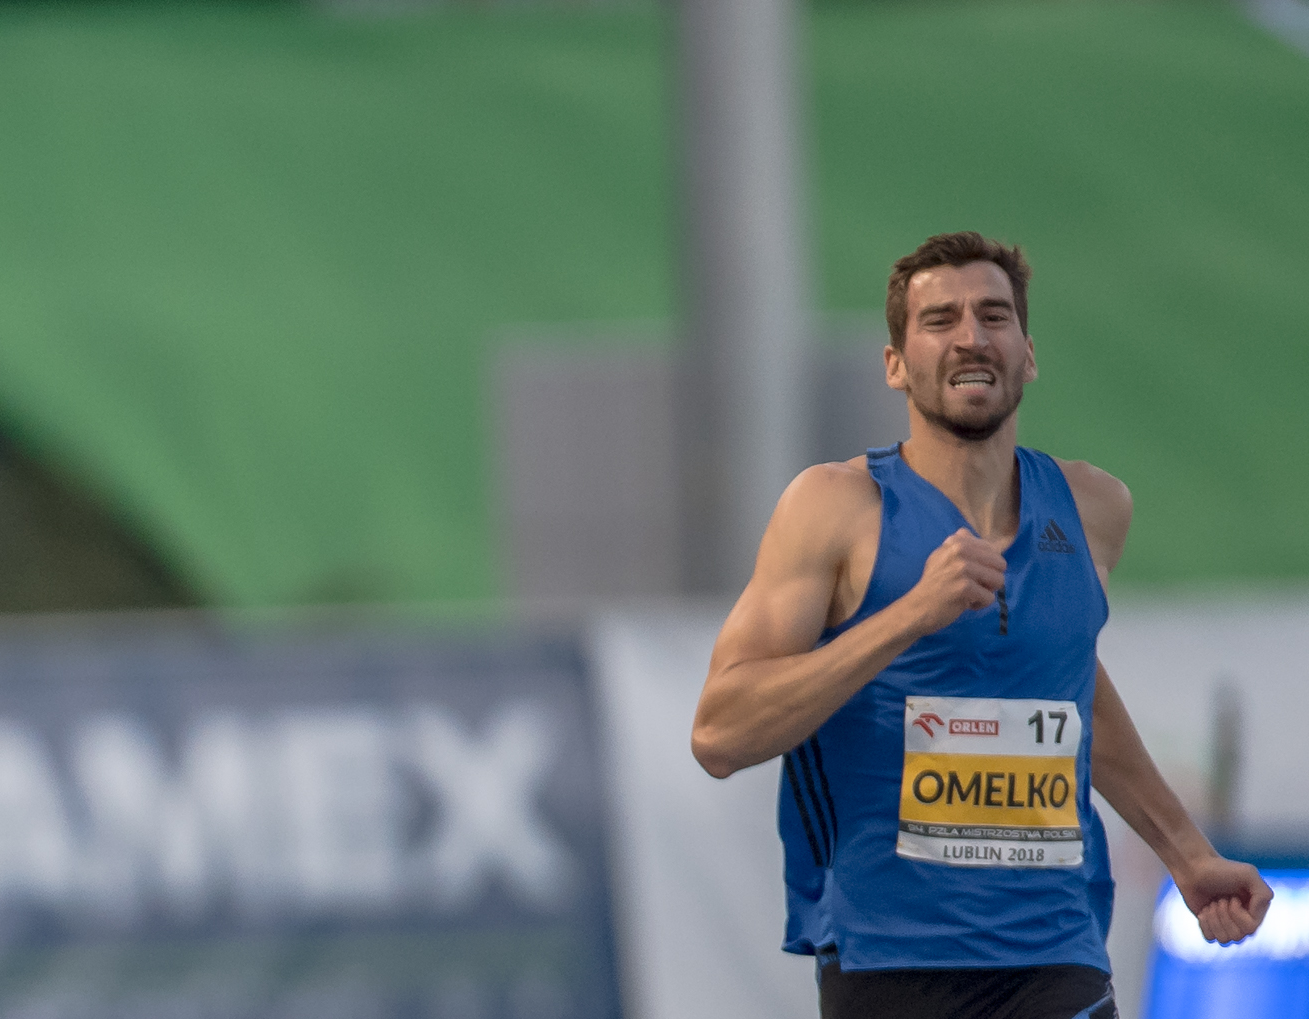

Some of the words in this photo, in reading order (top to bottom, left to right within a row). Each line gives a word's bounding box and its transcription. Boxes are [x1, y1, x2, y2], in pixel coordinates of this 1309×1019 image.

[951, 721, 997, 734] ORLEN
[1028, 710, 1068, 744] 17
[912, 768, 1070, 809] OMELKO
[929, 826, 958, 836] PZLA
[961, 828, 1041, 839] MISTRZOSTWA
[1044, 830, 1077, 839] POLSKI
[943, 845, 1002, 861] LUBLIN
[1008, 848, 1044, 862] 2018
